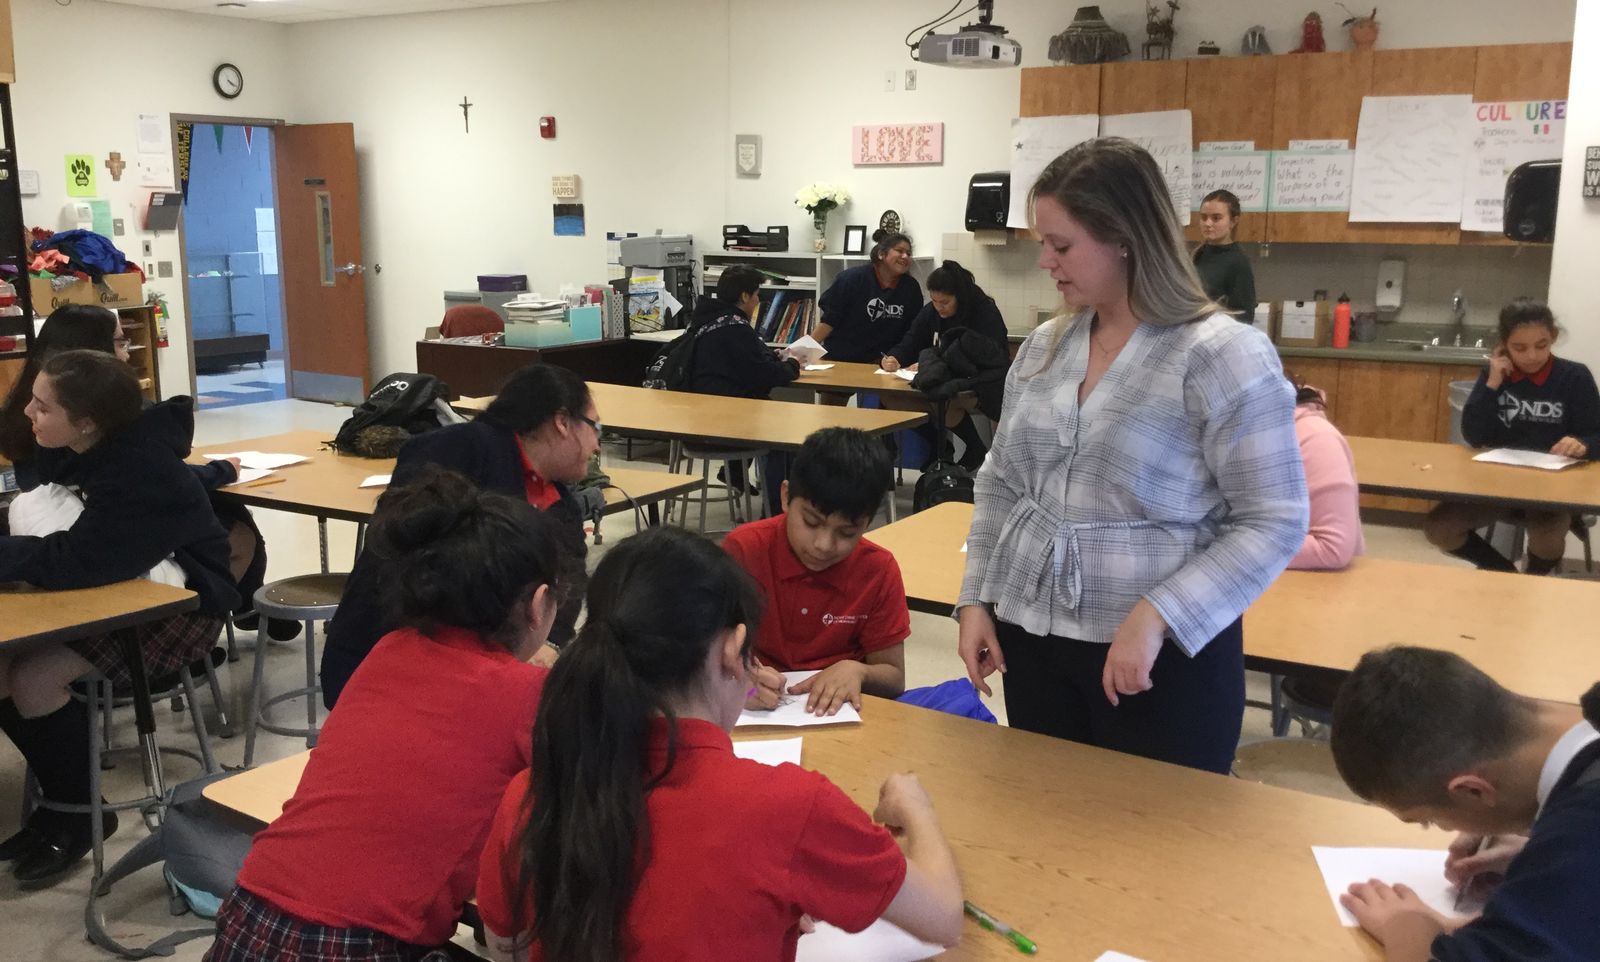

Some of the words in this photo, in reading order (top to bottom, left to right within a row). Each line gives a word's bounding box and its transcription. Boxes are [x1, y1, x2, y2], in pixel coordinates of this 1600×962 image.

[1476, 101, 1567, 122] CULTURE
[861, 125, 934, 162] LOVE
[1278, 167, 1301, 180] What
[1308, 172, 1317, 180] is
[1325, 162, 1345, 176] the
[552, 187, 574, 196] HAPPEN
[1314, 176, 1327, 189] of
[884, 304, 905, 315] NDS
[1520, 400, 1563, 418] NDS
